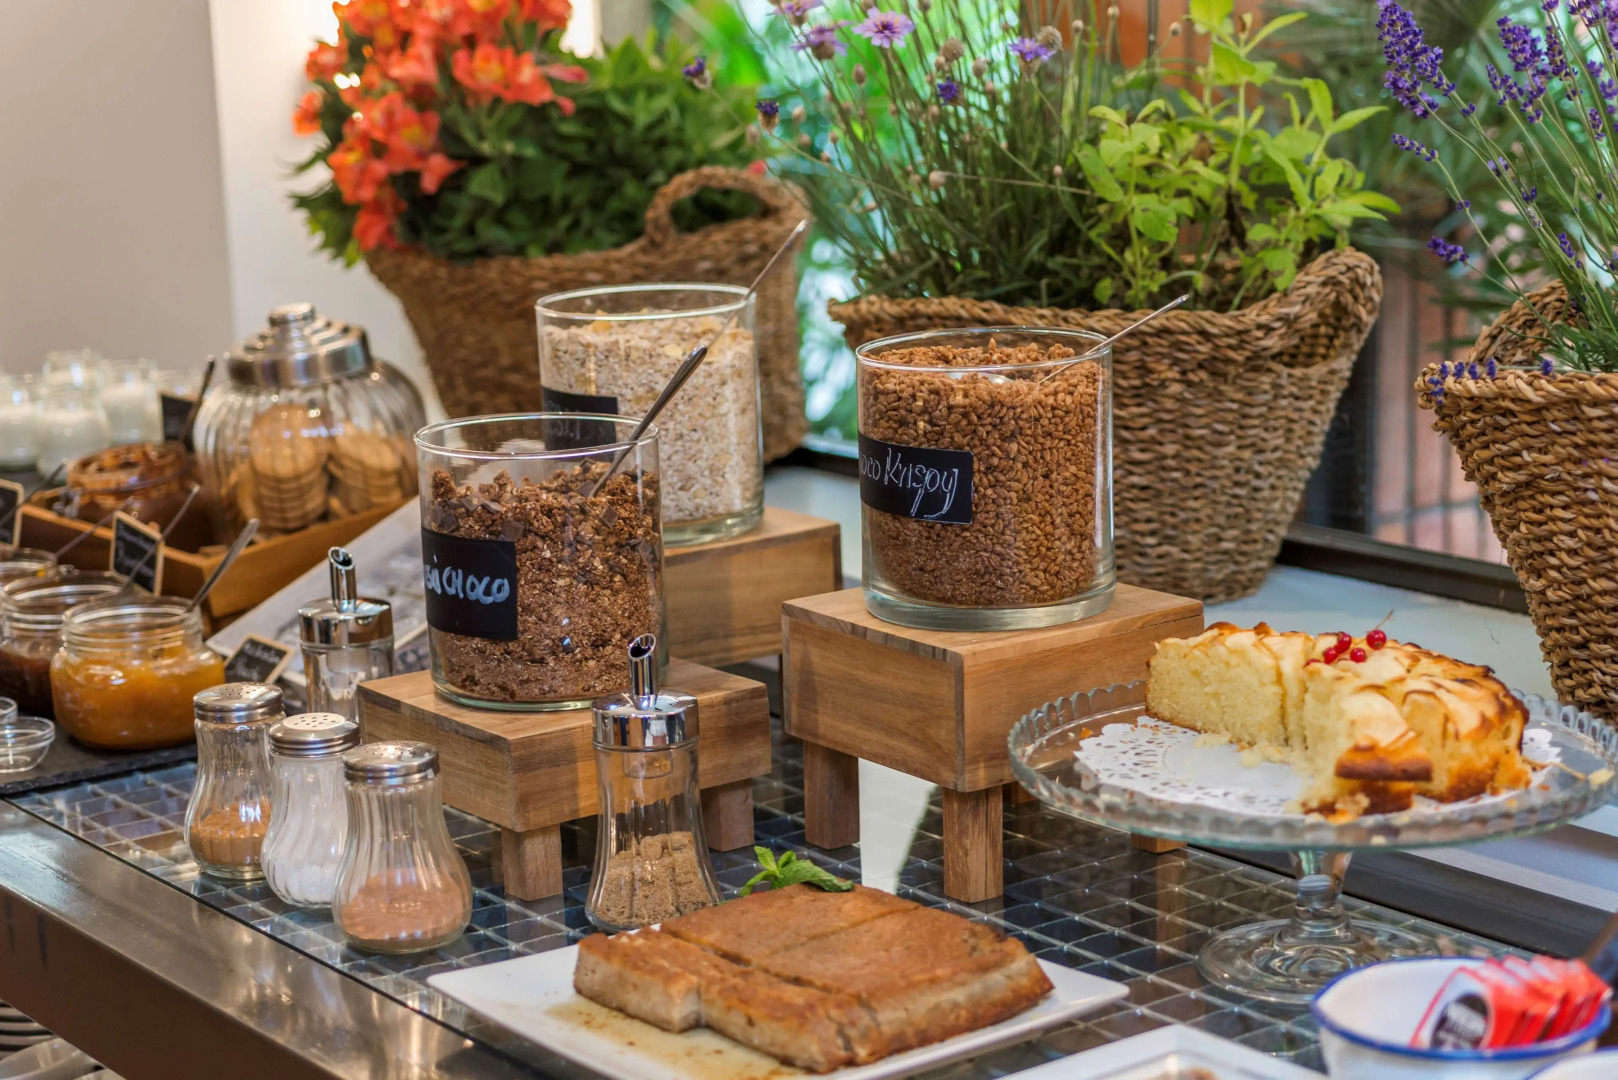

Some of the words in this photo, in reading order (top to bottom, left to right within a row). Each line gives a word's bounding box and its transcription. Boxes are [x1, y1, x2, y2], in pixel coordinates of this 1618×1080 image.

[859, 452, 881, 481] oco
[884, 447, 959, 519] Krispy
[442, 566, 511, 605] CHOCO
